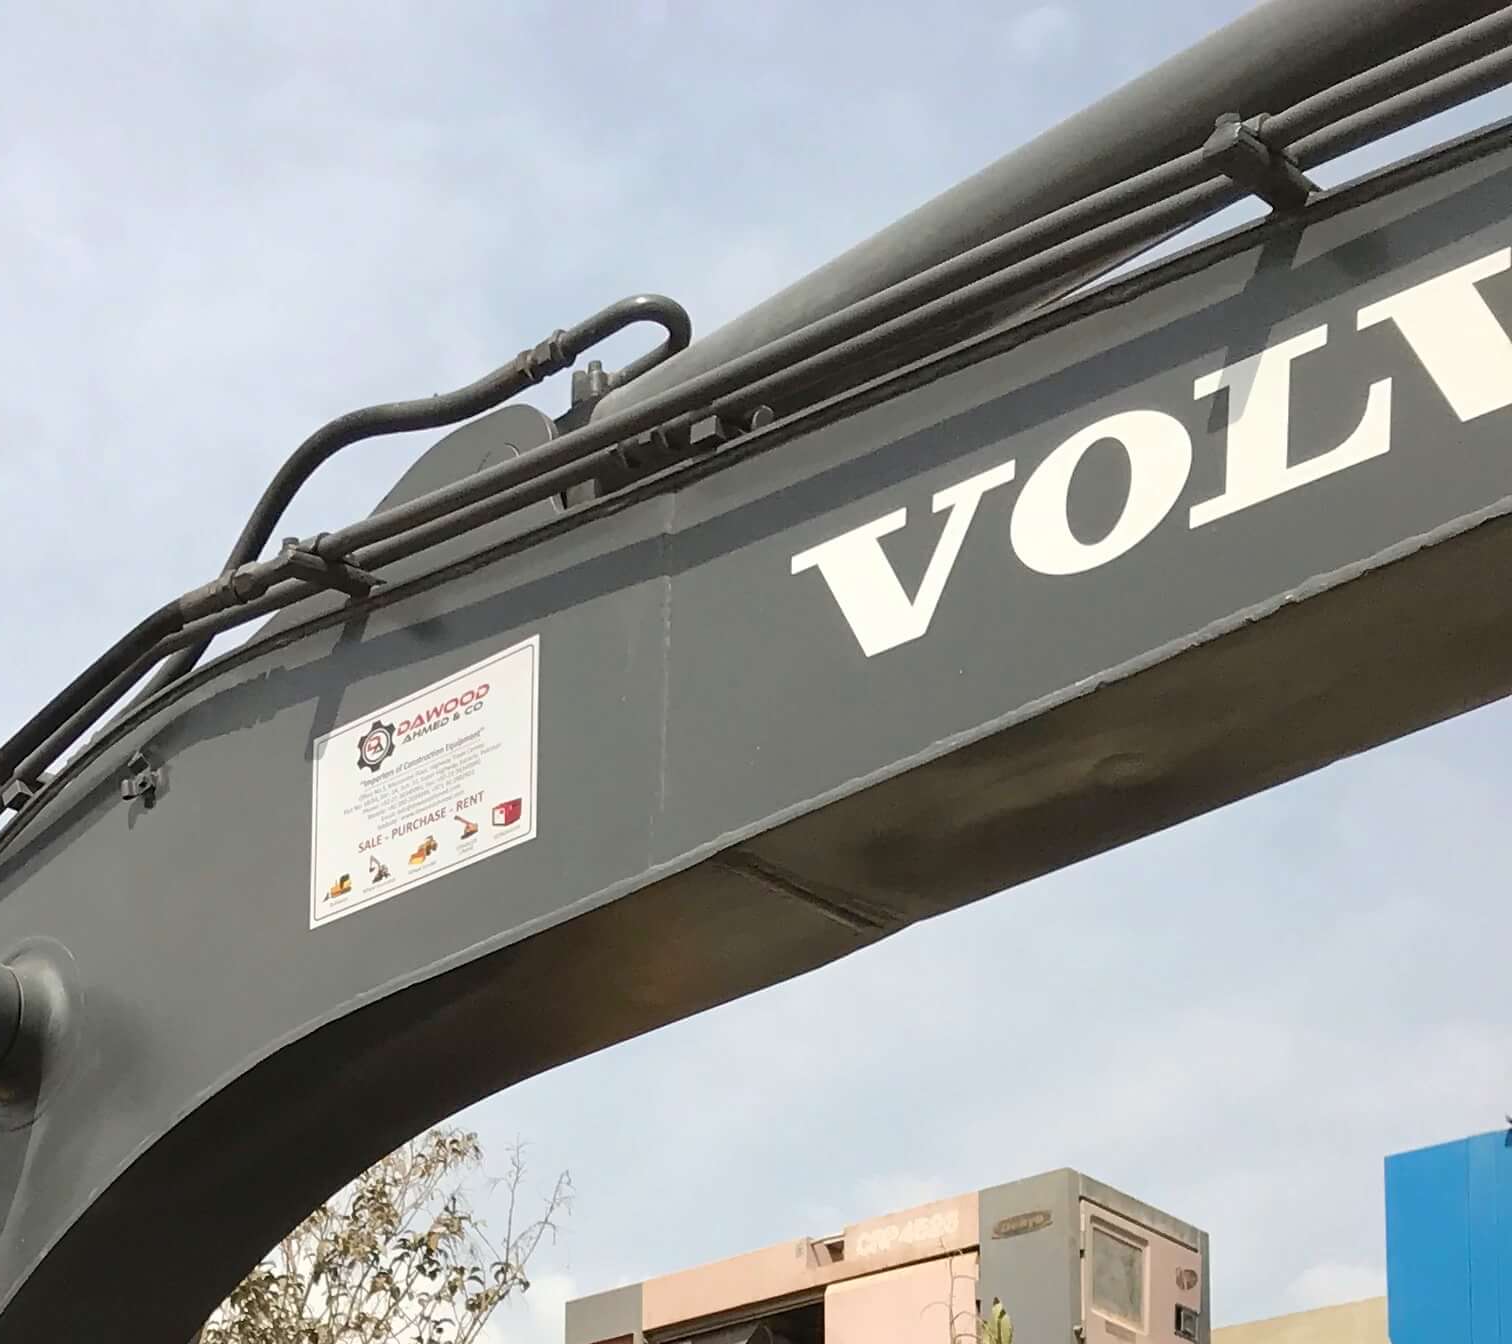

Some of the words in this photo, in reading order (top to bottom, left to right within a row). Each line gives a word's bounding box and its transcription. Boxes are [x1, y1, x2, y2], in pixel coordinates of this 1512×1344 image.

[397, 684, 490, 736] DAWOOD
[401, 716, 449, 744] AHMED
[464, 701, 484, 716] CO
[358, 834, 383, 854] SALE
[392, 807, 447, 840] PURCHASE
[456, 790, 485, 813] RENT
